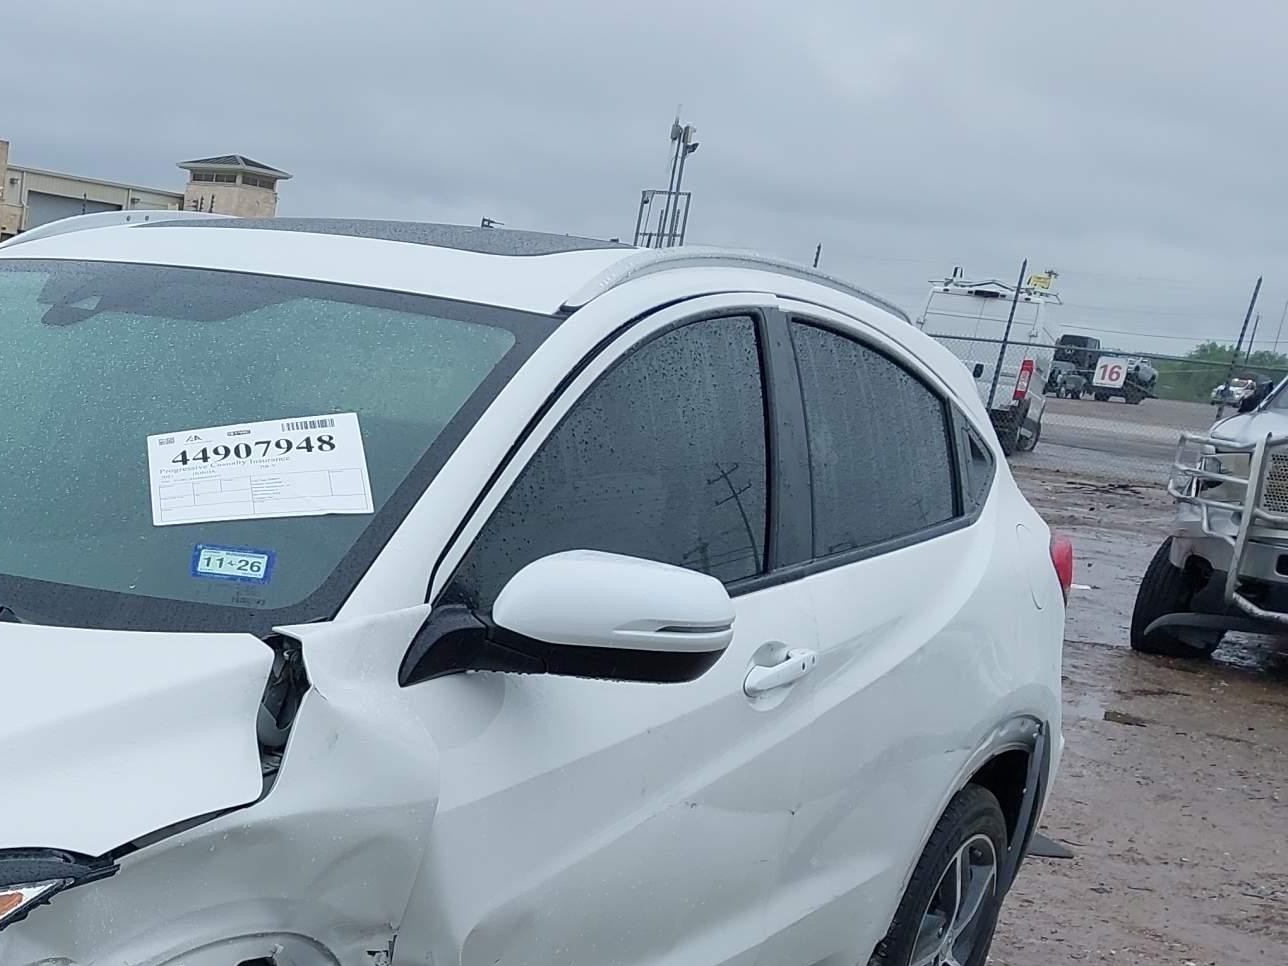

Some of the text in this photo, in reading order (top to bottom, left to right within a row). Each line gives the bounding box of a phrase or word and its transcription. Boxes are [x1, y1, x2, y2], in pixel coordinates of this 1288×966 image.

[1099, 364, 1122, 382] 16
[171, 434, 336, 465] 44907948
[203, 556, 262, 573] 11 26
